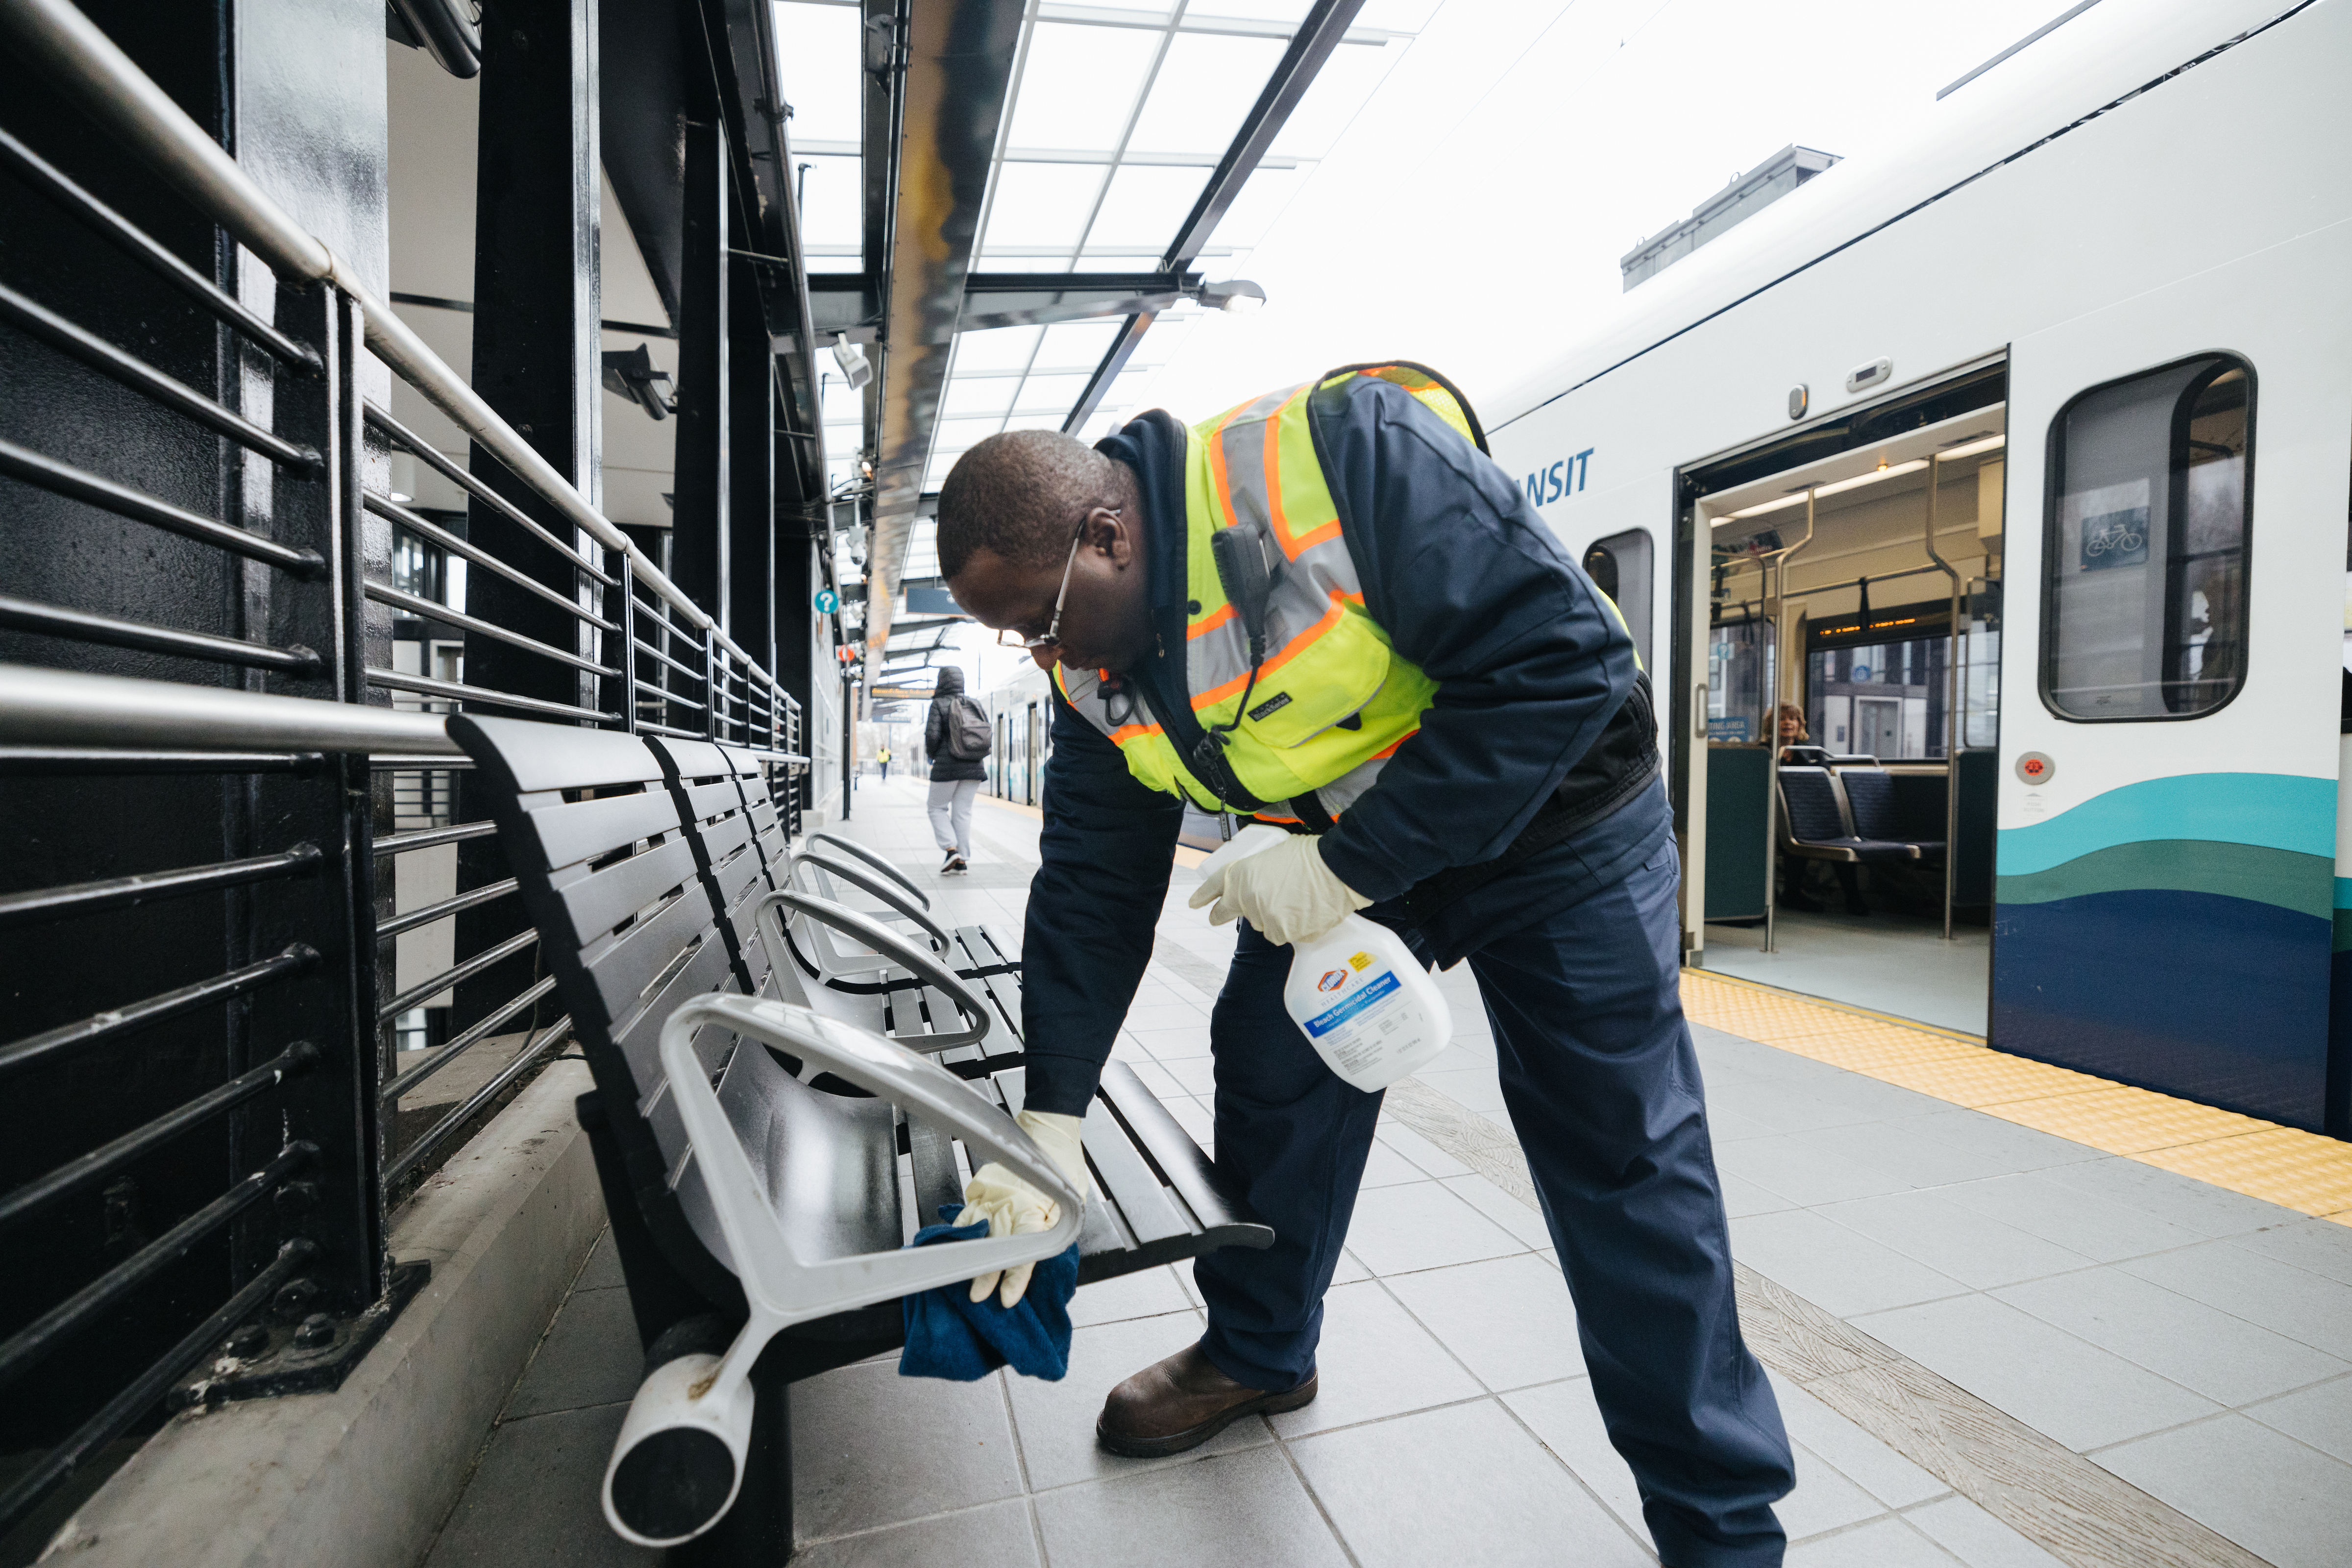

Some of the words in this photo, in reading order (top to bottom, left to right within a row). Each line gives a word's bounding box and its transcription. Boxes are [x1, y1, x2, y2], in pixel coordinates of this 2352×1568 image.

[1516, 446, 1594, 507] NSIT
[1321, 968, 1345, 993] CLOROX
[1321, 977, 1364, 1007] HEALTHCARE
[1313, 1009, 1334, 1028] Bleach
[1333, 991, 1367, 1017] Germicidal
[1367, 976, 1392, 996] Cleaner
